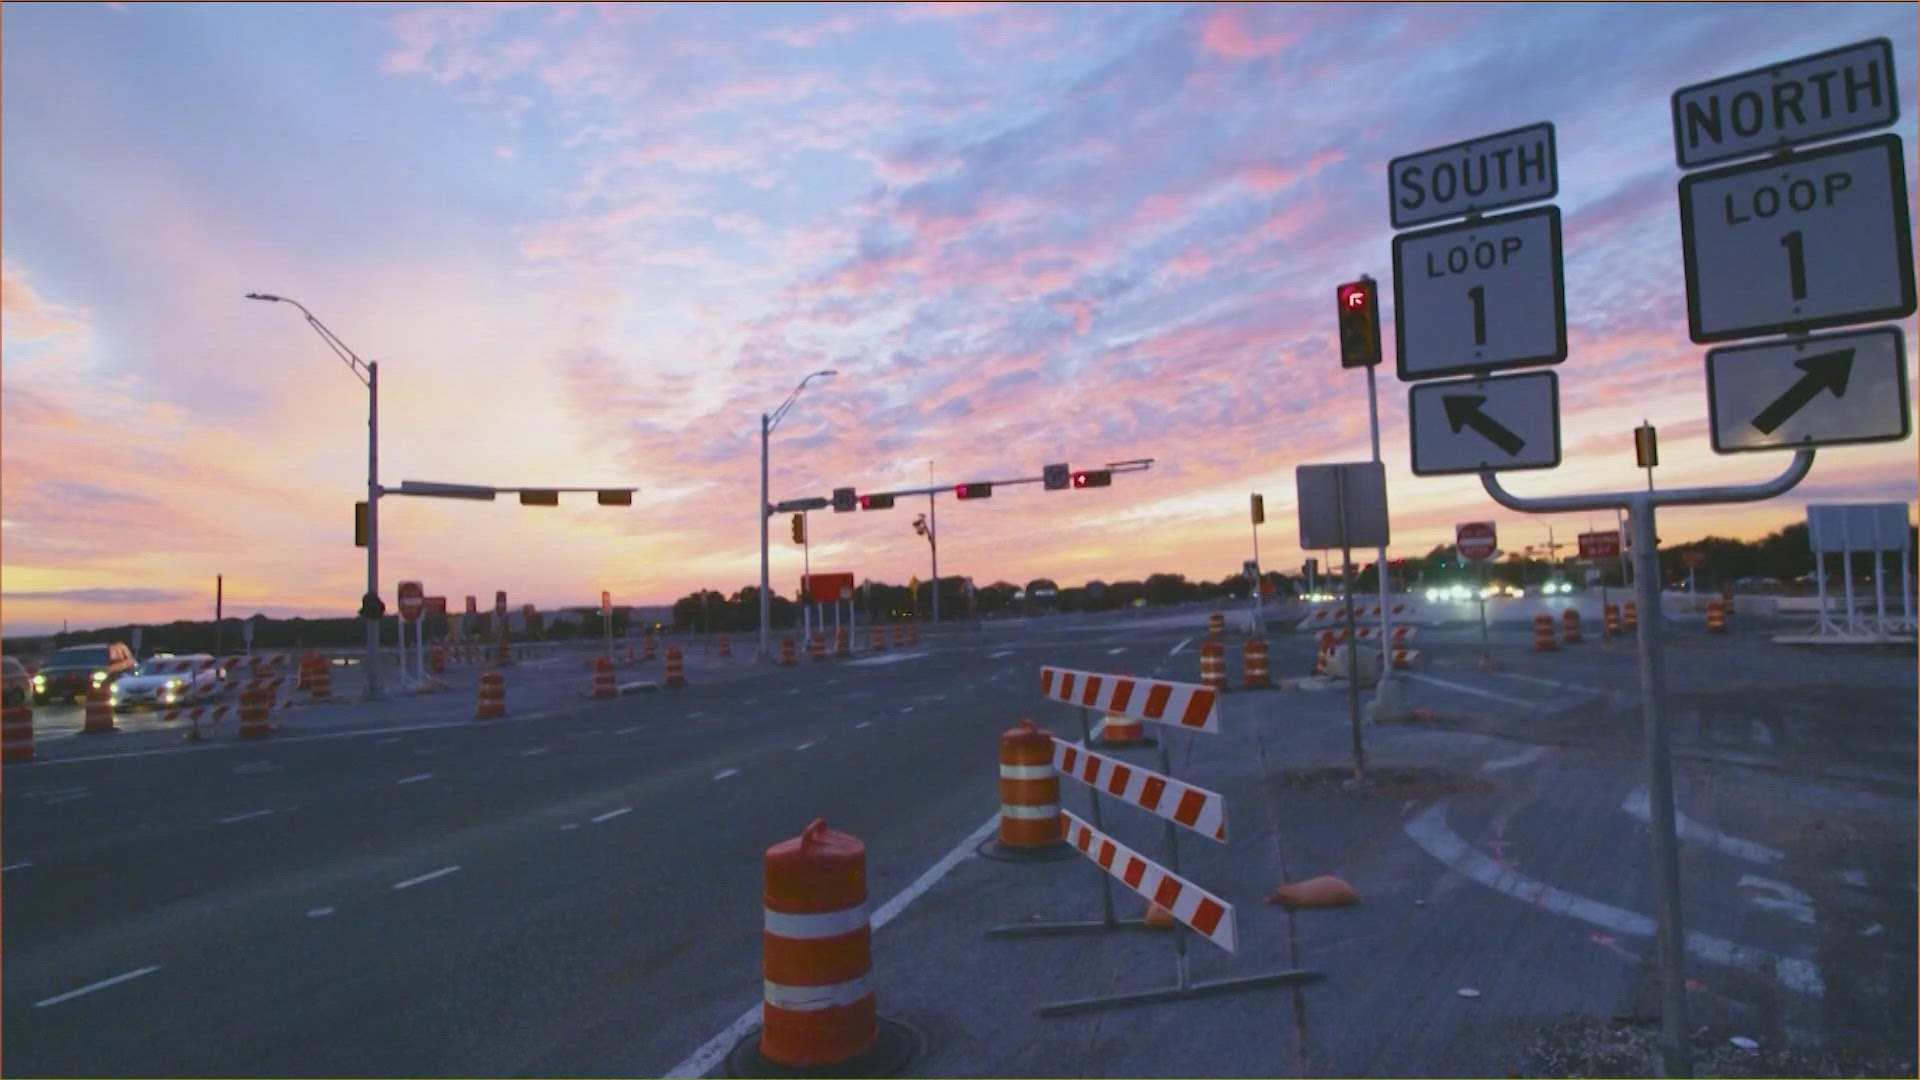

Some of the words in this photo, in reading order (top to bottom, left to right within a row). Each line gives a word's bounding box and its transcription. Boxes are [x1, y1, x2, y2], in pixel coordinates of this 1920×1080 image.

[1686, 60, 1882, 148] NORTH
[1400, 140, 1546, 210] SOUTH
[1725, 172, 1853, 225] LOOP
[1426, 236, 1523, 278] LOOP
[1780, 230, 1807, 300] 1
[1467, 284, 1487, 346] 1
